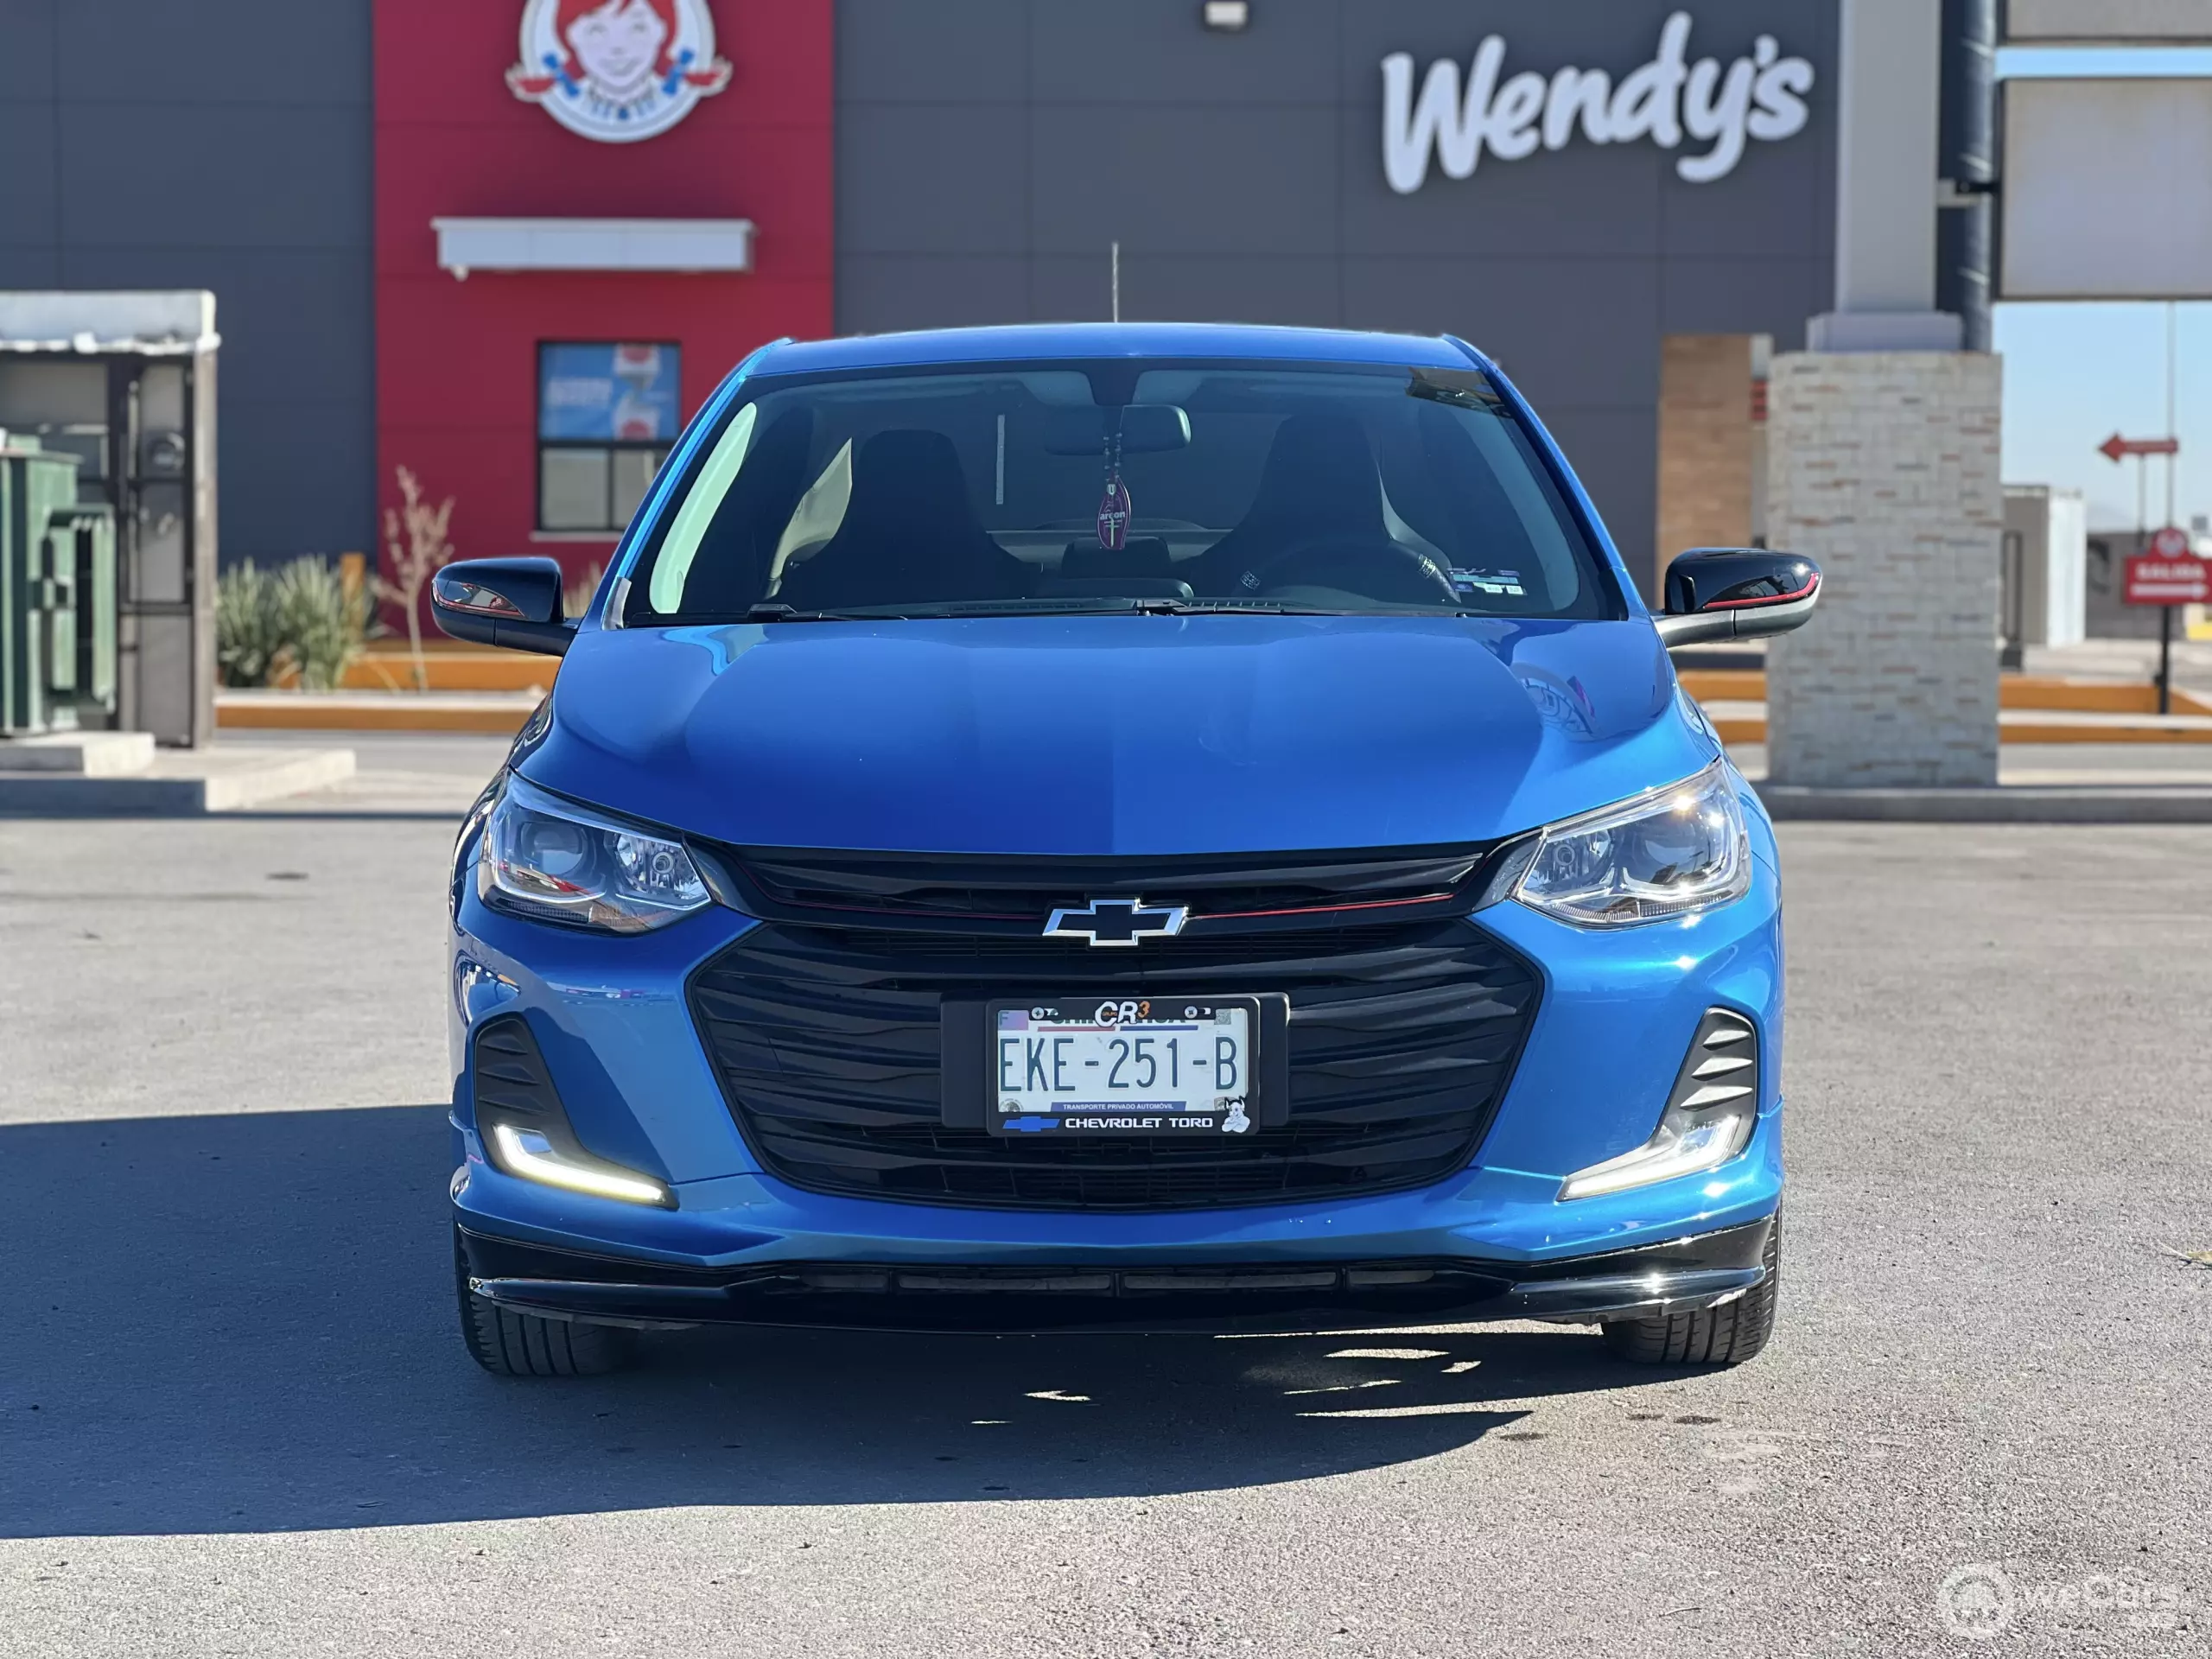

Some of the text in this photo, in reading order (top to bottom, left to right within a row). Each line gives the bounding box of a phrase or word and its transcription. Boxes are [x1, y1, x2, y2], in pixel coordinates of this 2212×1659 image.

[1381, 10, 1815, 194] Wendy's
[999, 1037, 1237, 1091] EKE-251-B
[1065, 1117, 1214, 1129] CHEVROLET TORO
